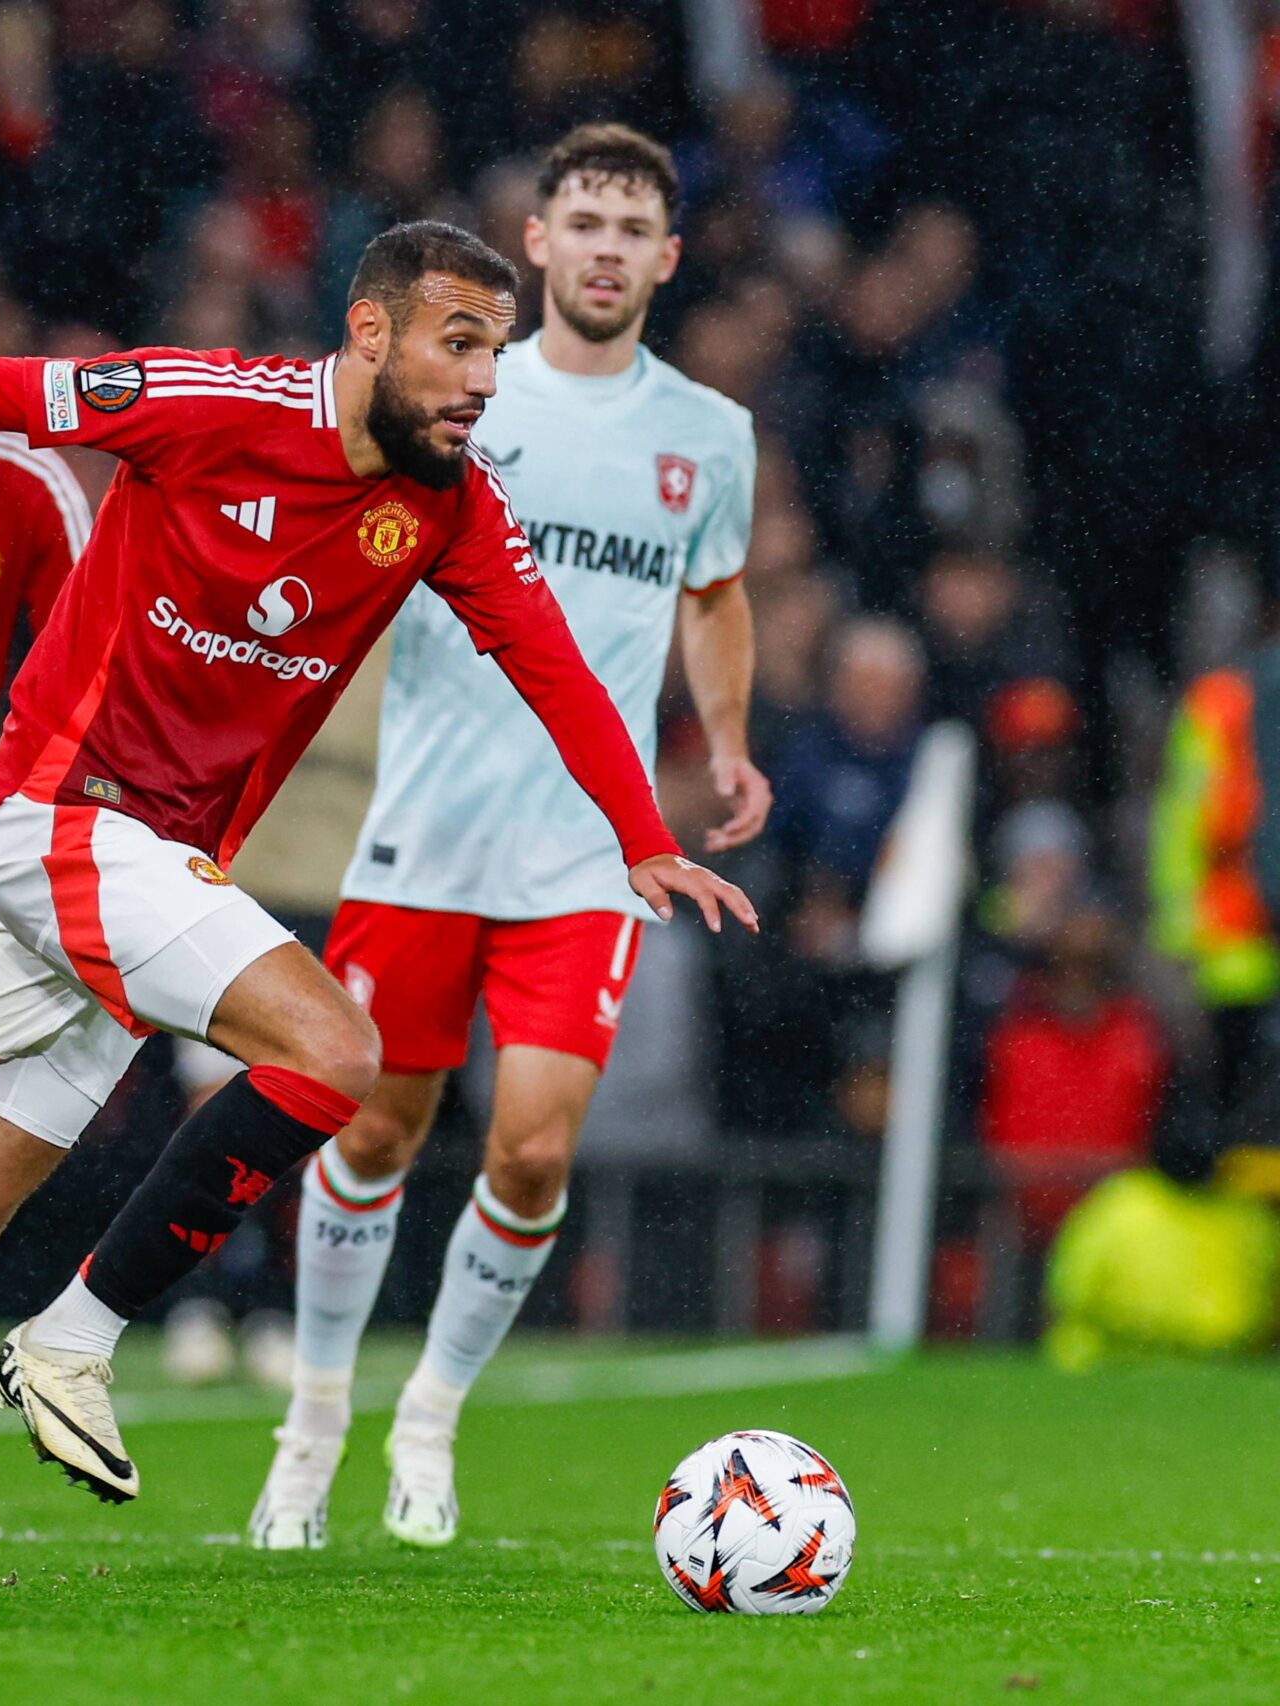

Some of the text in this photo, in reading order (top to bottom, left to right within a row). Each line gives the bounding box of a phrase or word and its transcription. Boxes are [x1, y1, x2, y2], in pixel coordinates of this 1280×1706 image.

[366, 506, 414, 531] MANCHESTER
[366, 548, 400, 563] UNITED
[519, 519, 675, 588] KTRAMA
